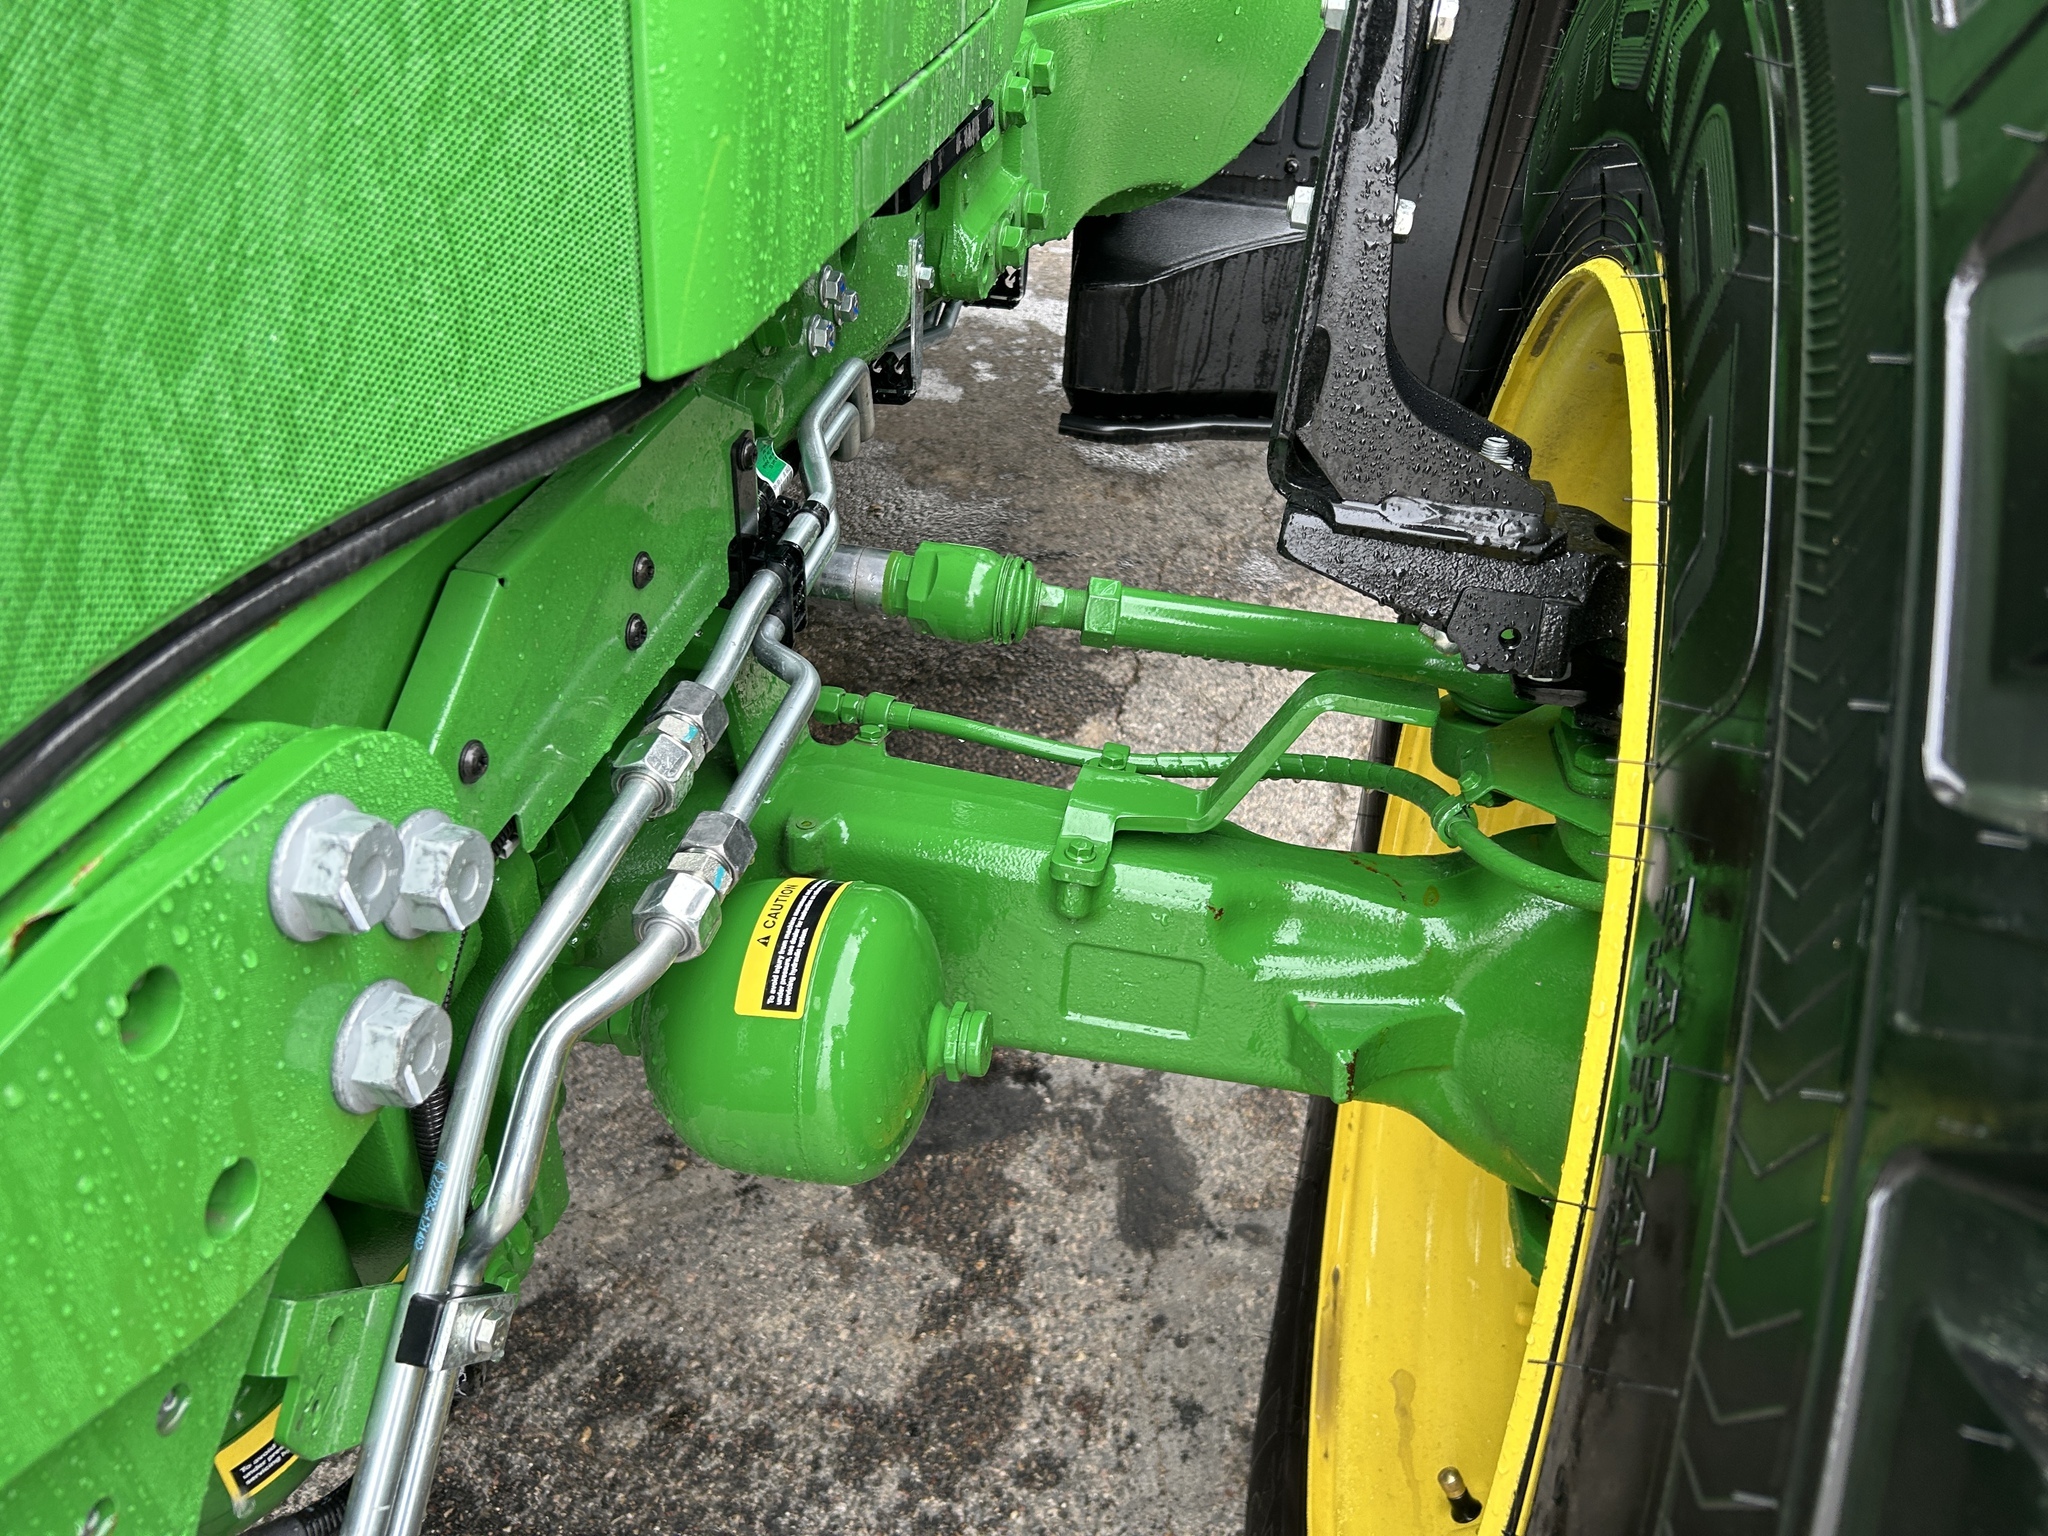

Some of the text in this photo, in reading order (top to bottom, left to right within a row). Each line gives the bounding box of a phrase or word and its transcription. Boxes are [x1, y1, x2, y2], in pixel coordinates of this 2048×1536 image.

[763, 884, 798, 929] CAUTION
[773, 955, 785, 974] injury
[769, 974, 779, 994] avoid
[776, 986, 785, 1005] under
[784, 976, 796, 1006] servicing
[766, 995, 775, 1005] To
[239, 1443, 277, 1473] To avoid
[242, 1457, 266, 1480] under
[245, 1456, 282, 1486] servicing
